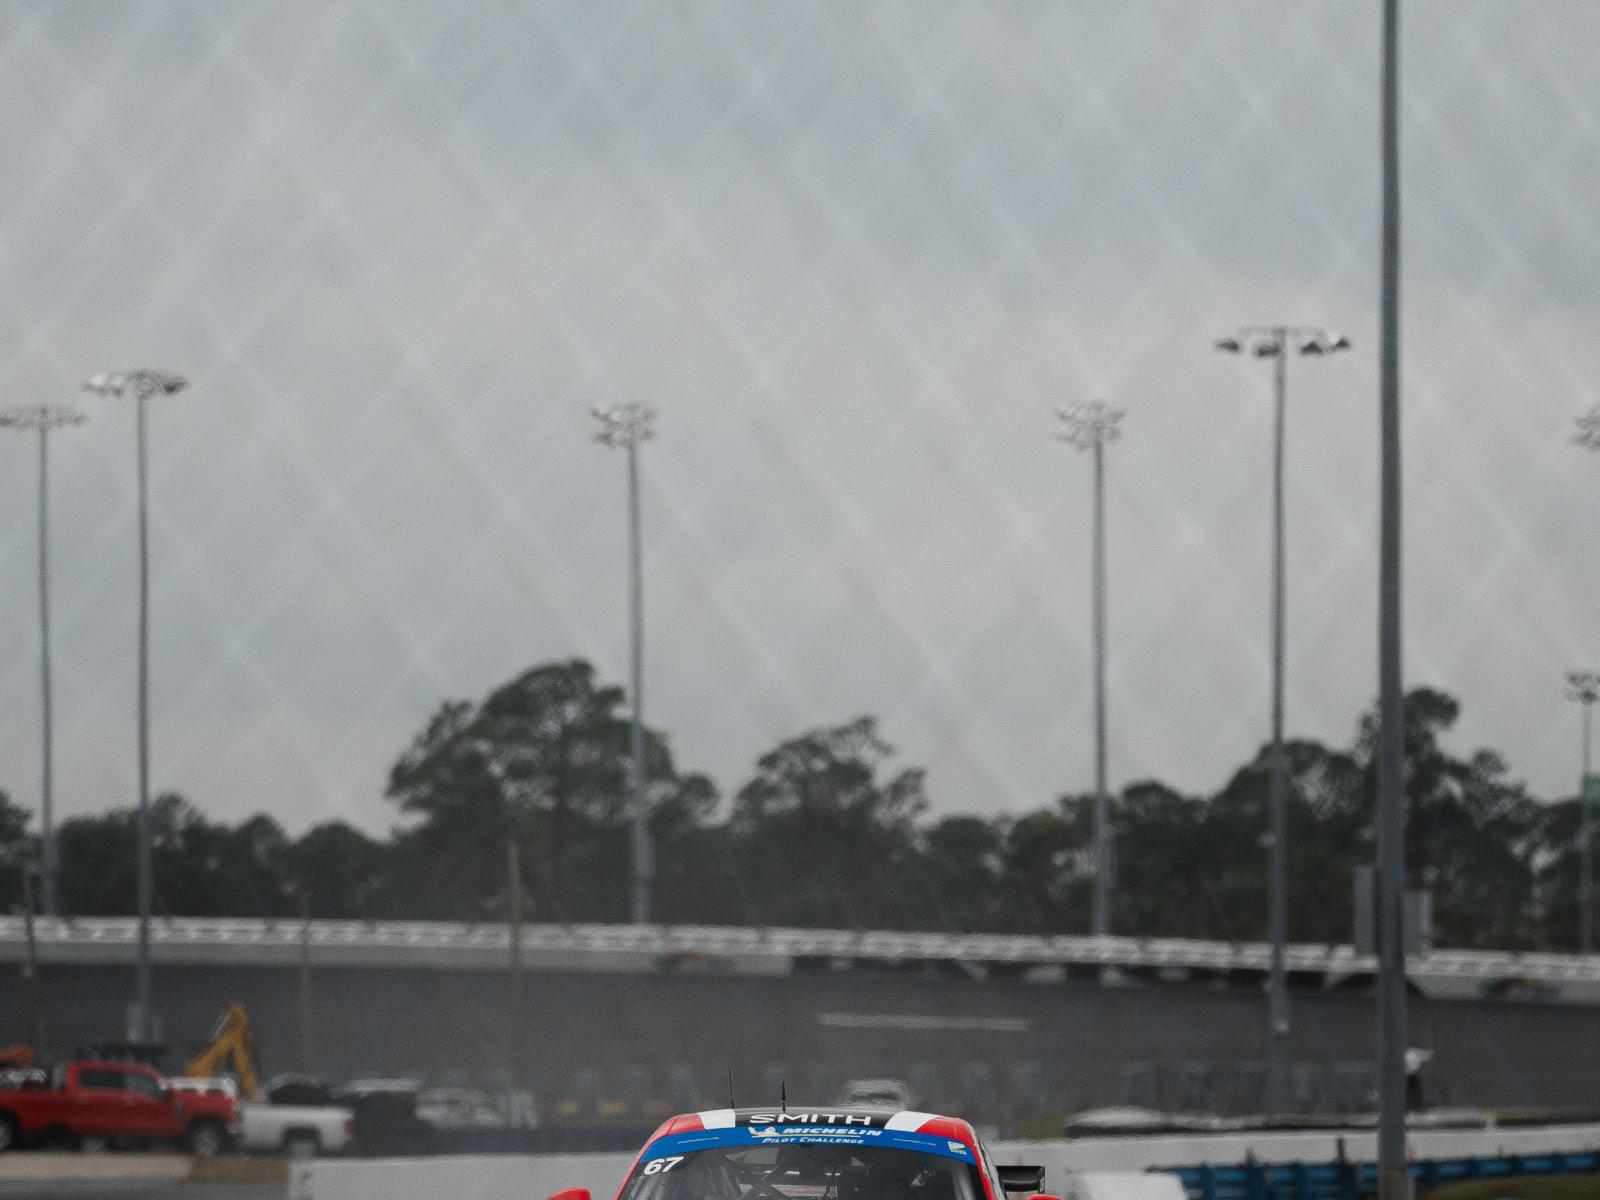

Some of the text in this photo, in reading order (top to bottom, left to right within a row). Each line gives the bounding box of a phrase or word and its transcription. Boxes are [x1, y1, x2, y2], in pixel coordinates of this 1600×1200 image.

[750, 1113, 871, 1126] SMITH
[783, 1127, 882, 1136] MICHELIN
[643, 1156, 684, 1175] 67
